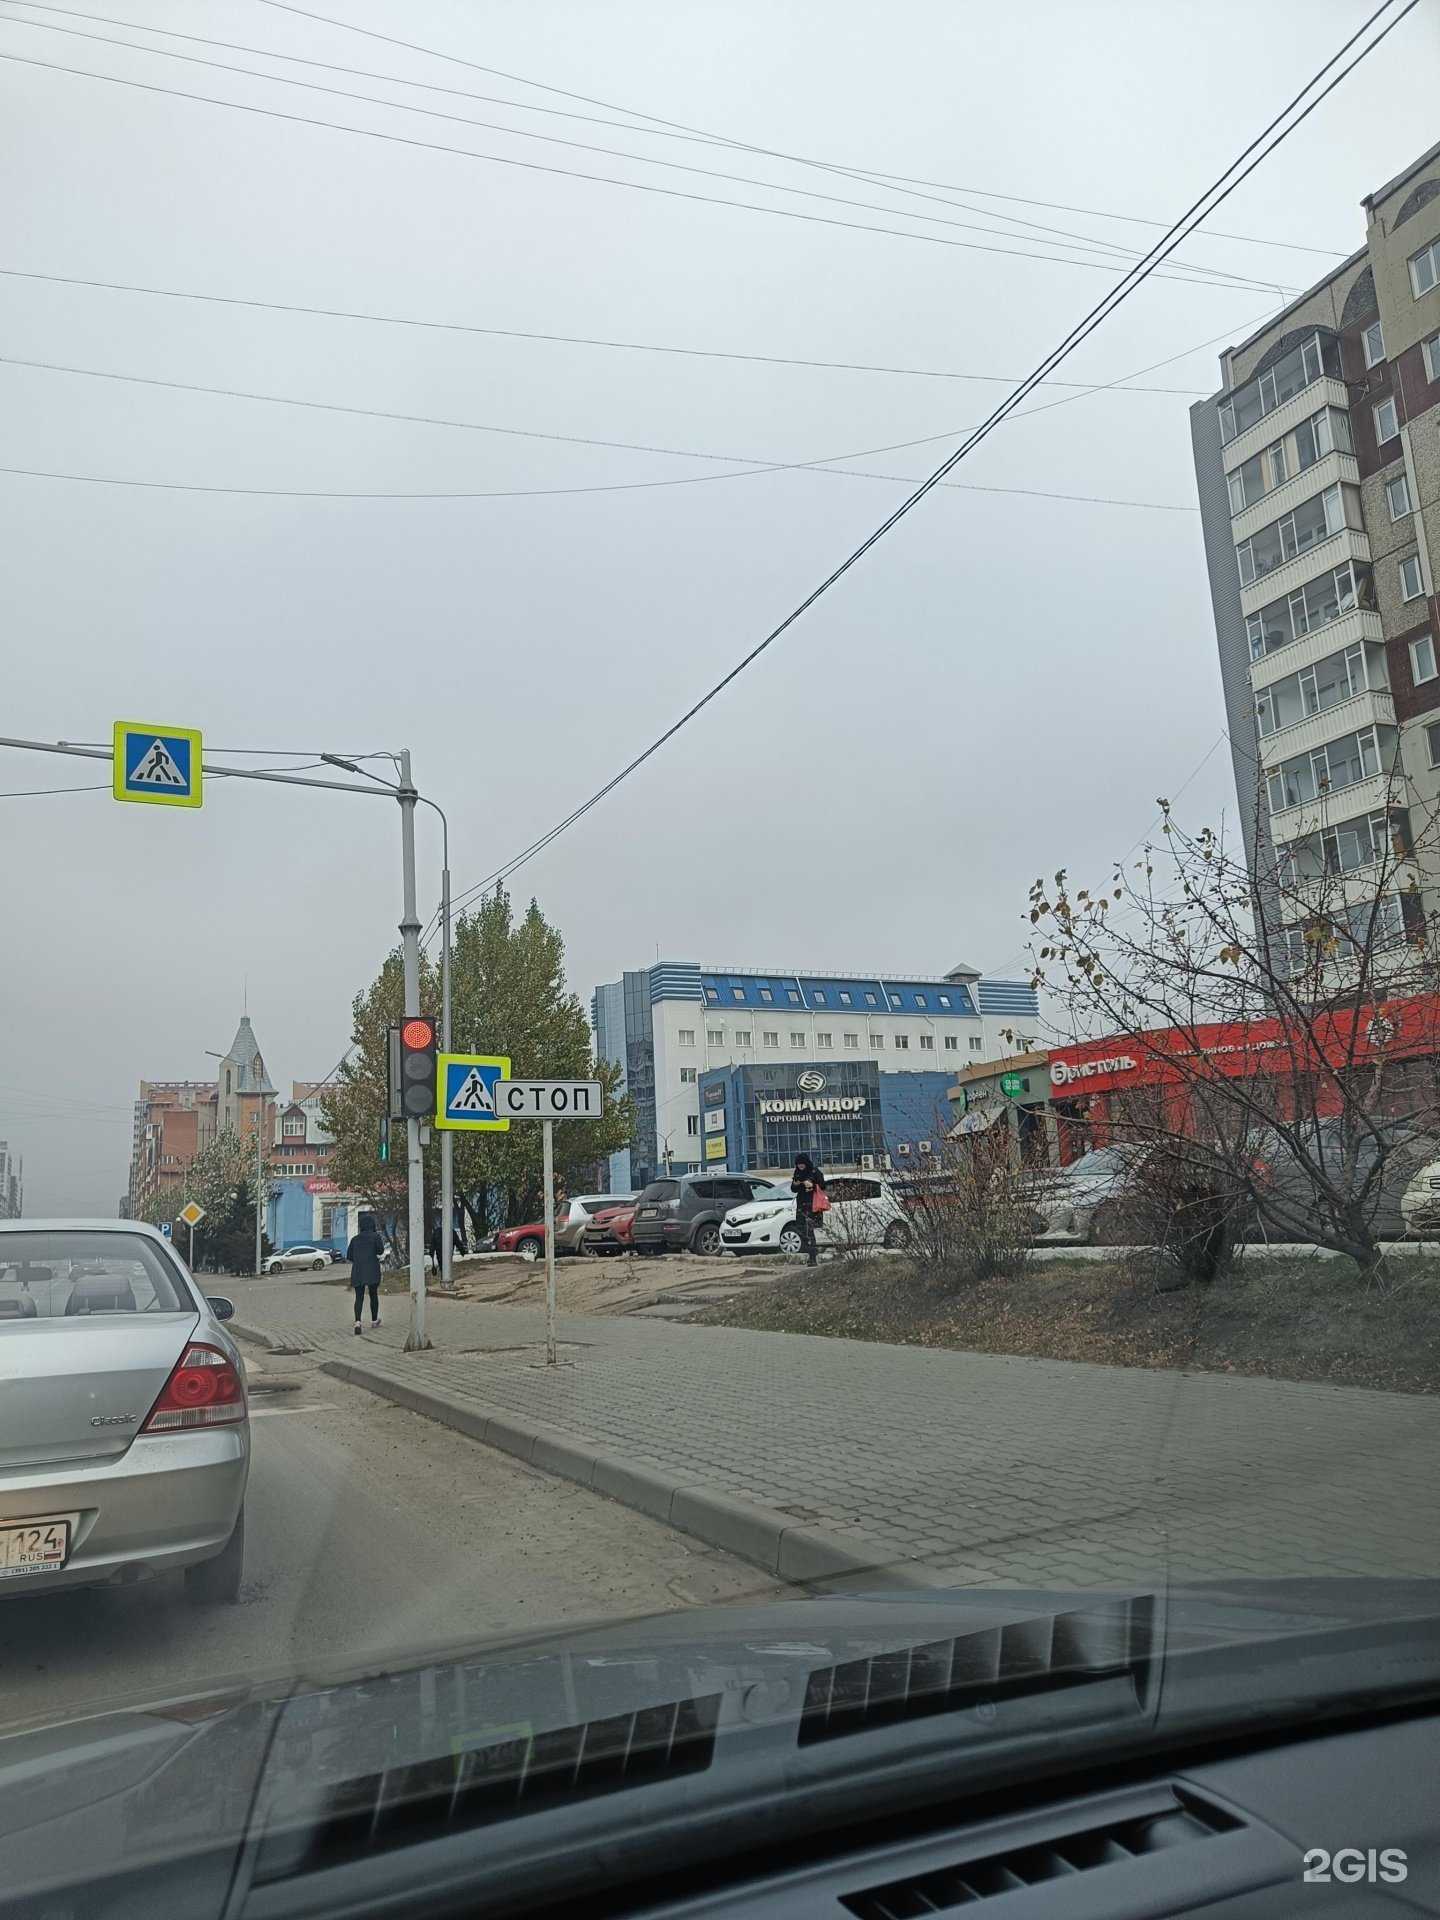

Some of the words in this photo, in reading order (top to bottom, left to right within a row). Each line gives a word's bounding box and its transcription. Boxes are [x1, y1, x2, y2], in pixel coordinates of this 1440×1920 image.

[507, 1087, 590, 1111] СТОП
[759, 1096, 866, 1114] КОМАНДОР
[766, 1112, 812, 1123] ТОРГОВЫЙ
[815, 1112, 864, 1121] КОМПЛЕКС
[16, 1527, 57, 1552] 124
[19, 1552, 44, 1562] RUS
